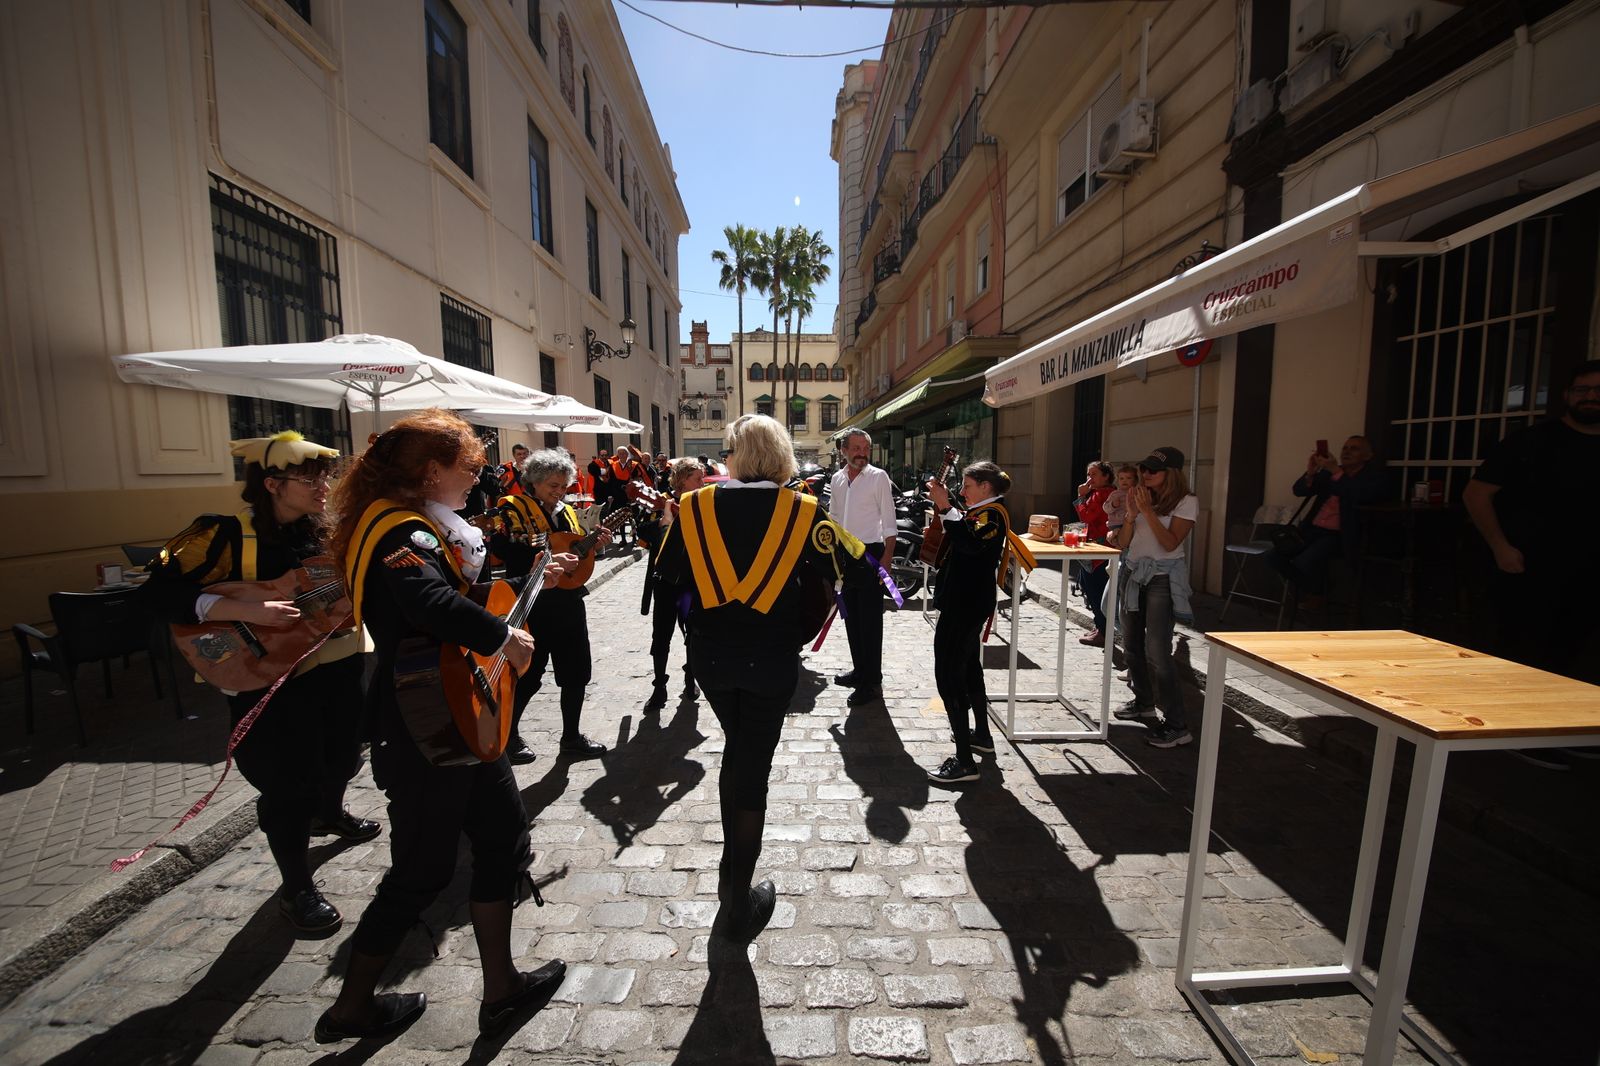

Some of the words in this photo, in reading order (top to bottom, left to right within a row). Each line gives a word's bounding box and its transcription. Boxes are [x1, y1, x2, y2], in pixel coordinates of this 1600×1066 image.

[1203, 262, 1299, 310] Cruzcampo
[1213, 295, 1276, 323] ESPECIAL
[1040, 357, 1056, 385] BAR
[1058, 352, 1069, 379] LA
[1071, 319, 1147, 375] MANZANILLA
